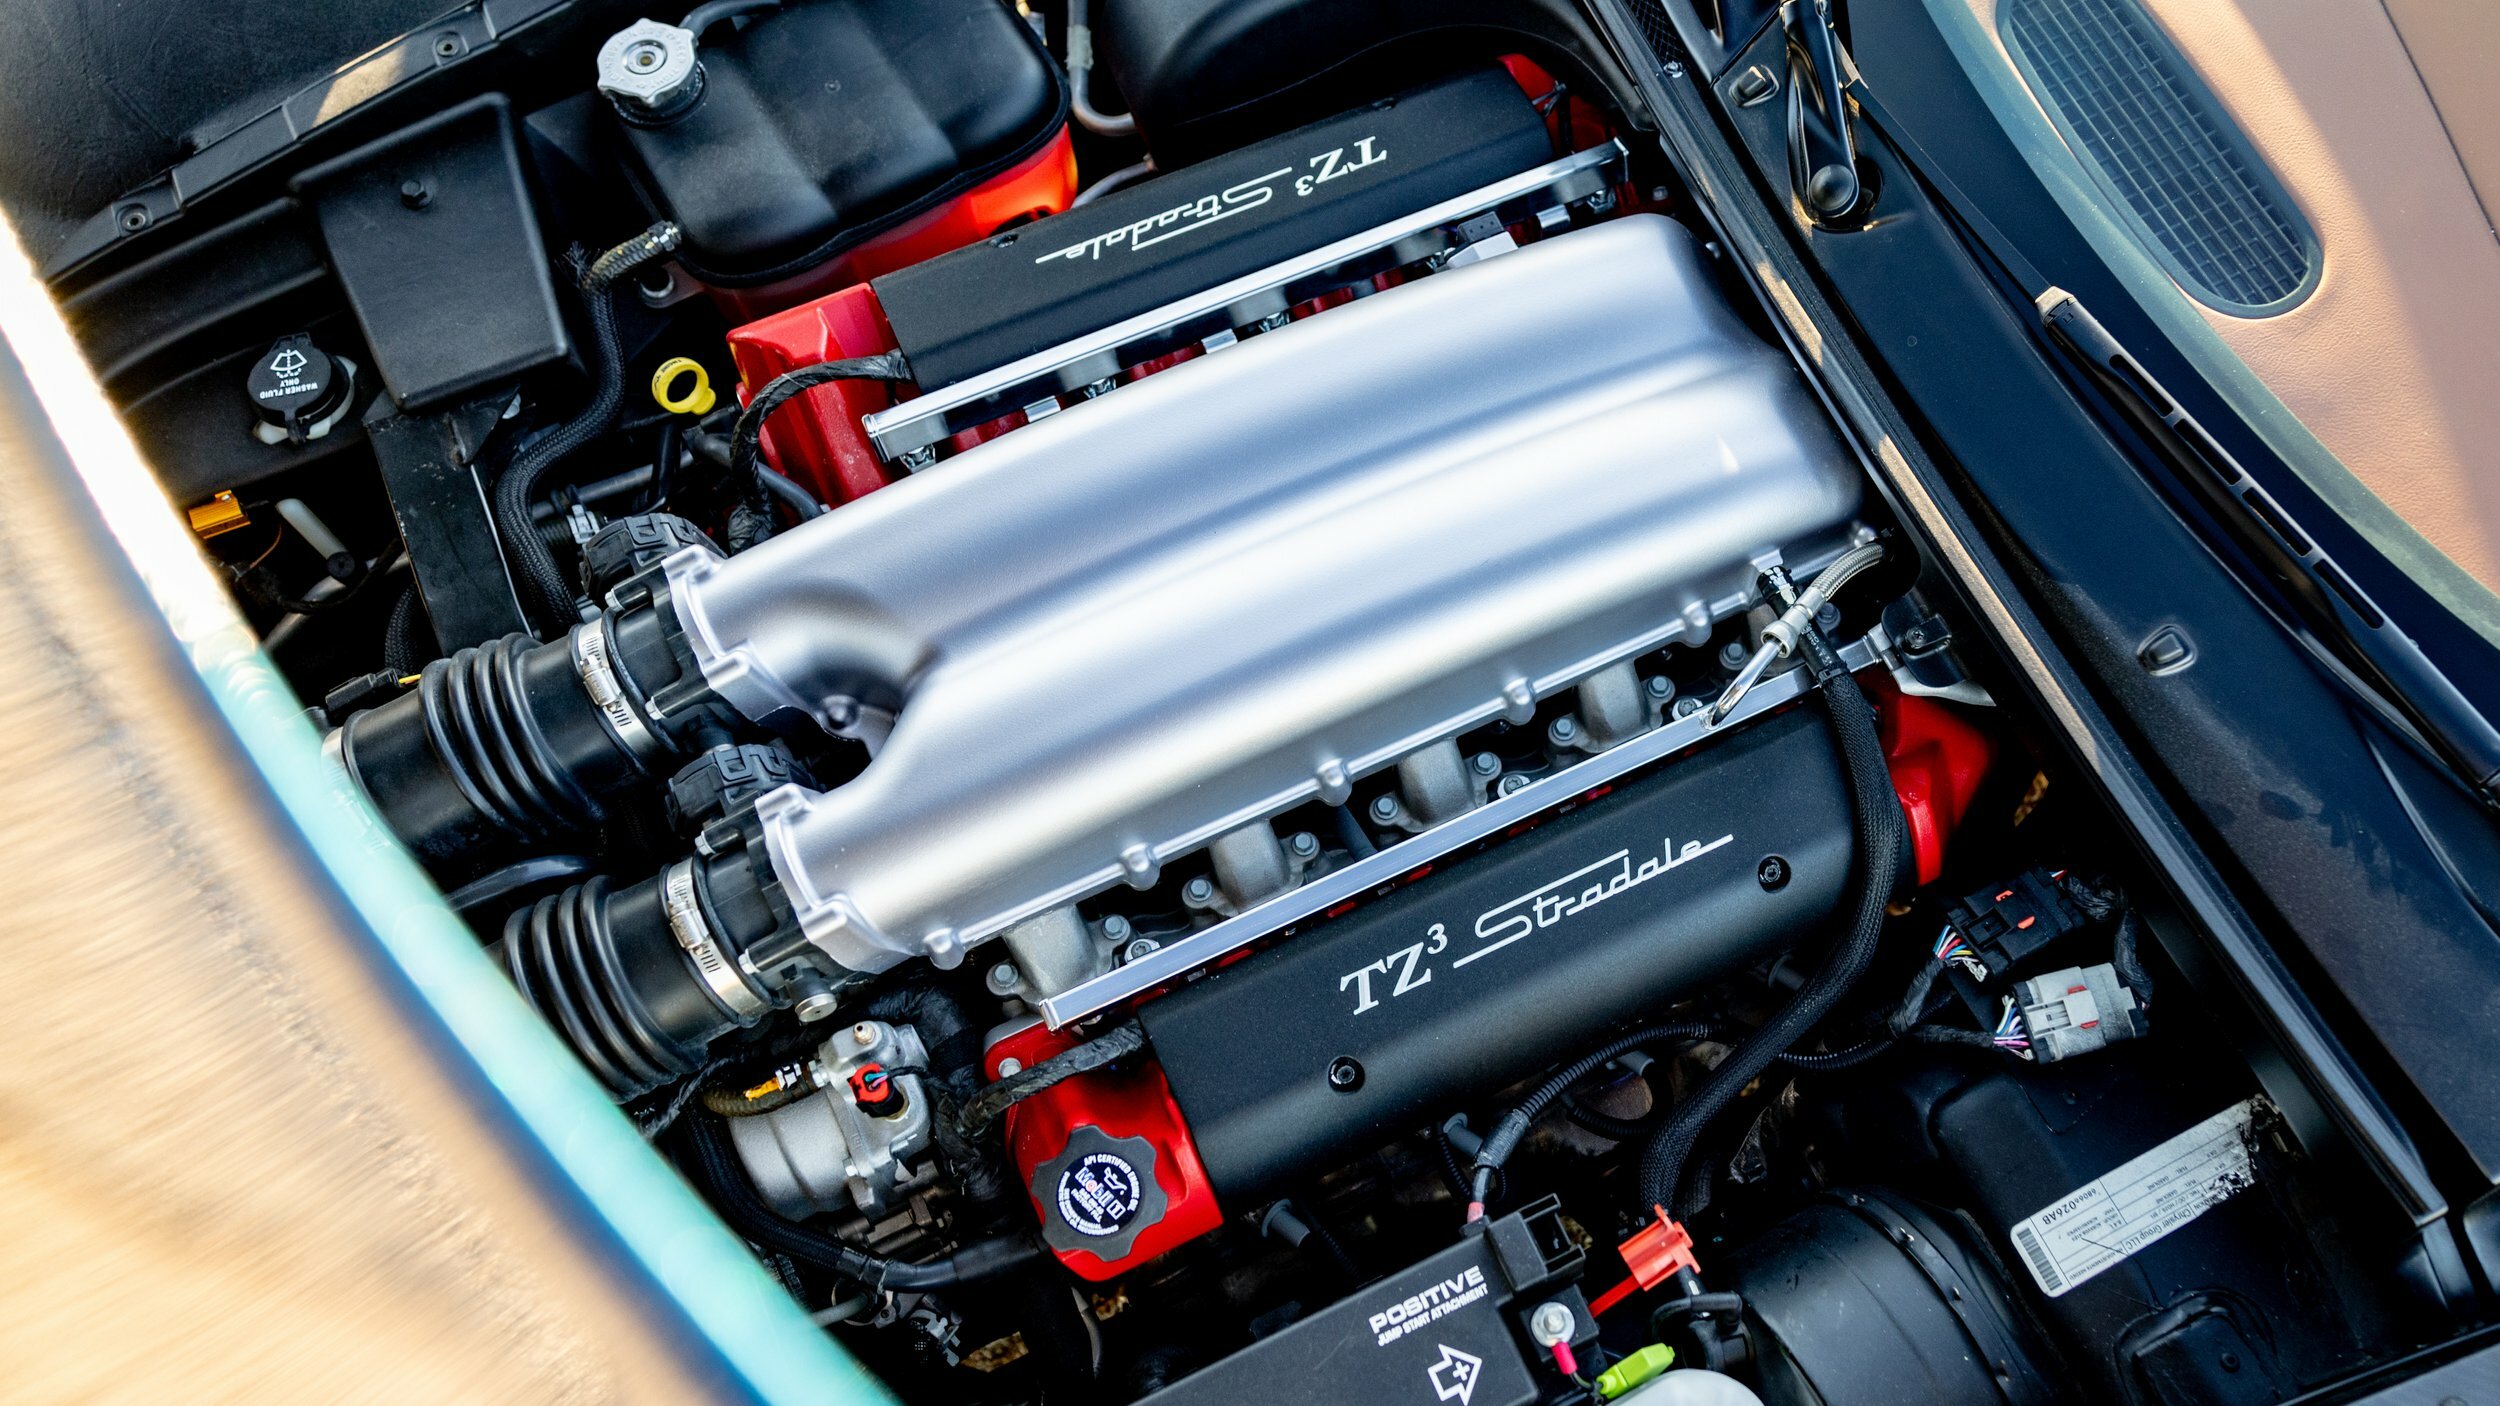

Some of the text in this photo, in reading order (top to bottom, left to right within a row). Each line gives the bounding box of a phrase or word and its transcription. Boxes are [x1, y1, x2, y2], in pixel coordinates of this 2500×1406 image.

[1035, 167, 1293, 264] Stradale
[259, 382, 318, 399] WASHER FLUID
[280, 377, 300, 387] ONLY
[1453, 834, 1734, 968] Stradale
[1084, 1154, 1140, 1211] API CERTIFIED ENGINE OIL
[2125, 1205, 2191, 1250] Chrysler Group LLC
[1368, 1265, 1485, 1334] POSITIVE
[1378, 1282, 1489, 1347] JUMP START ATTACHMENT
